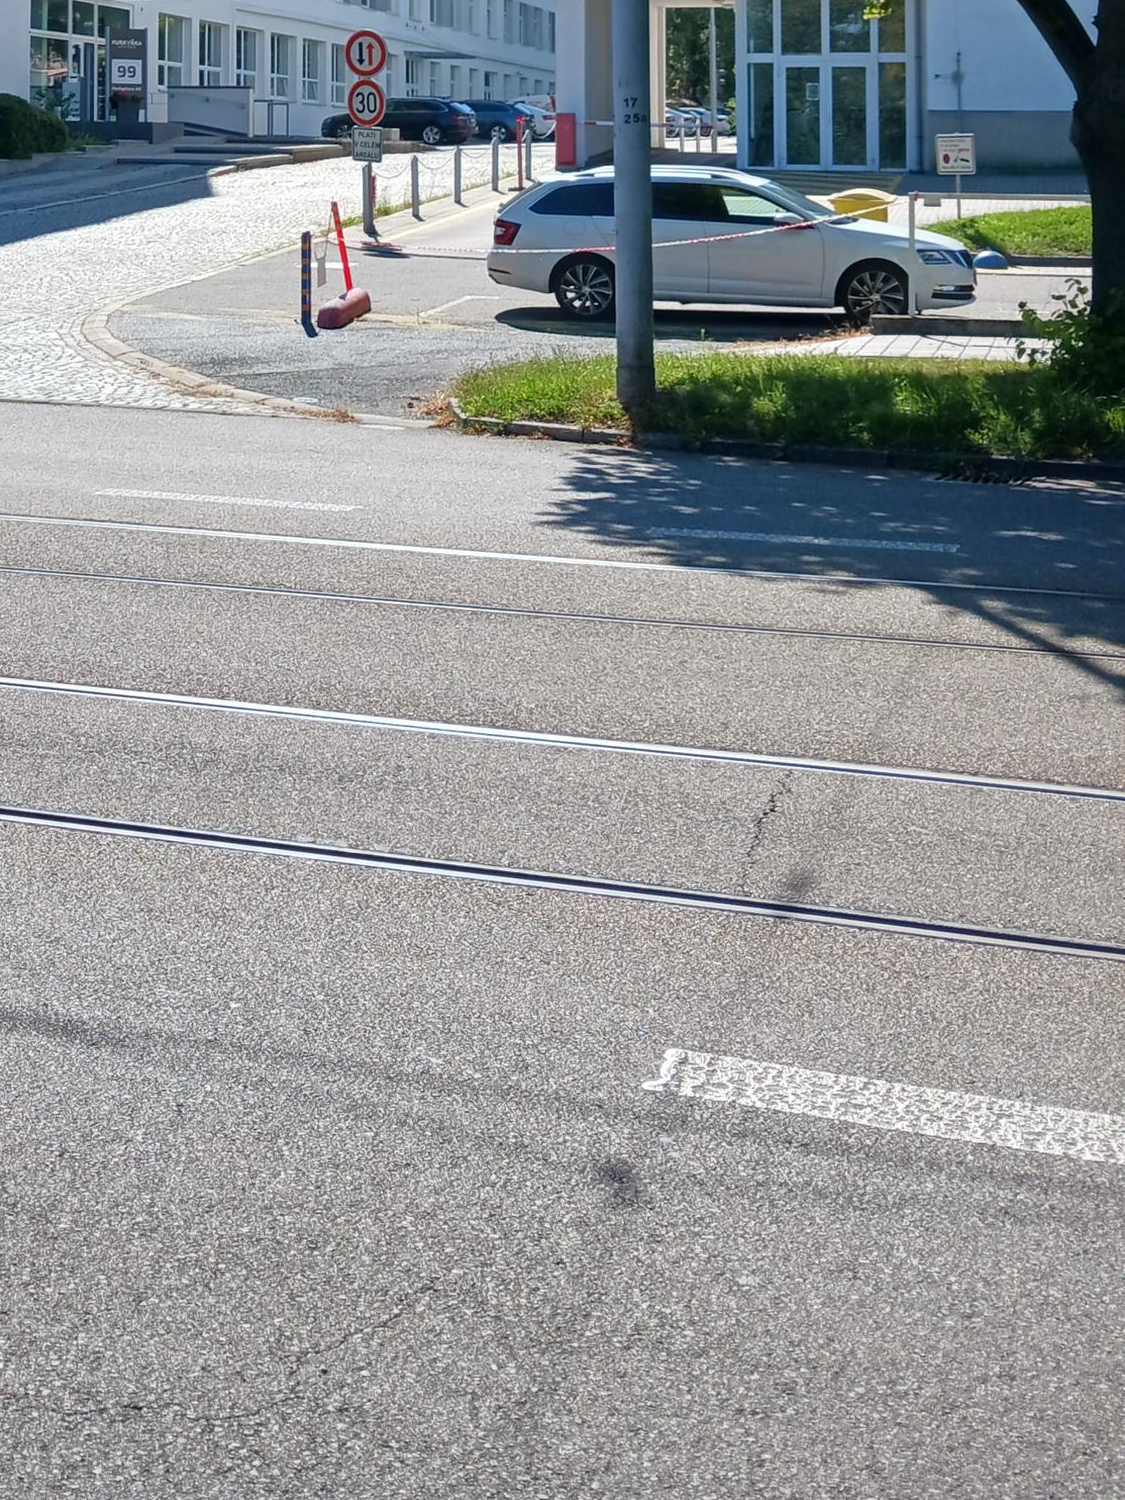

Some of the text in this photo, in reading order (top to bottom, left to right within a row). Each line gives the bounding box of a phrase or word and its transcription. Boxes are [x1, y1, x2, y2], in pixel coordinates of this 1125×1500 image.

[117, 65, 137, 78] 99
[356, 92, 377, 114] 30
[624, 97, 638, 108] 17
